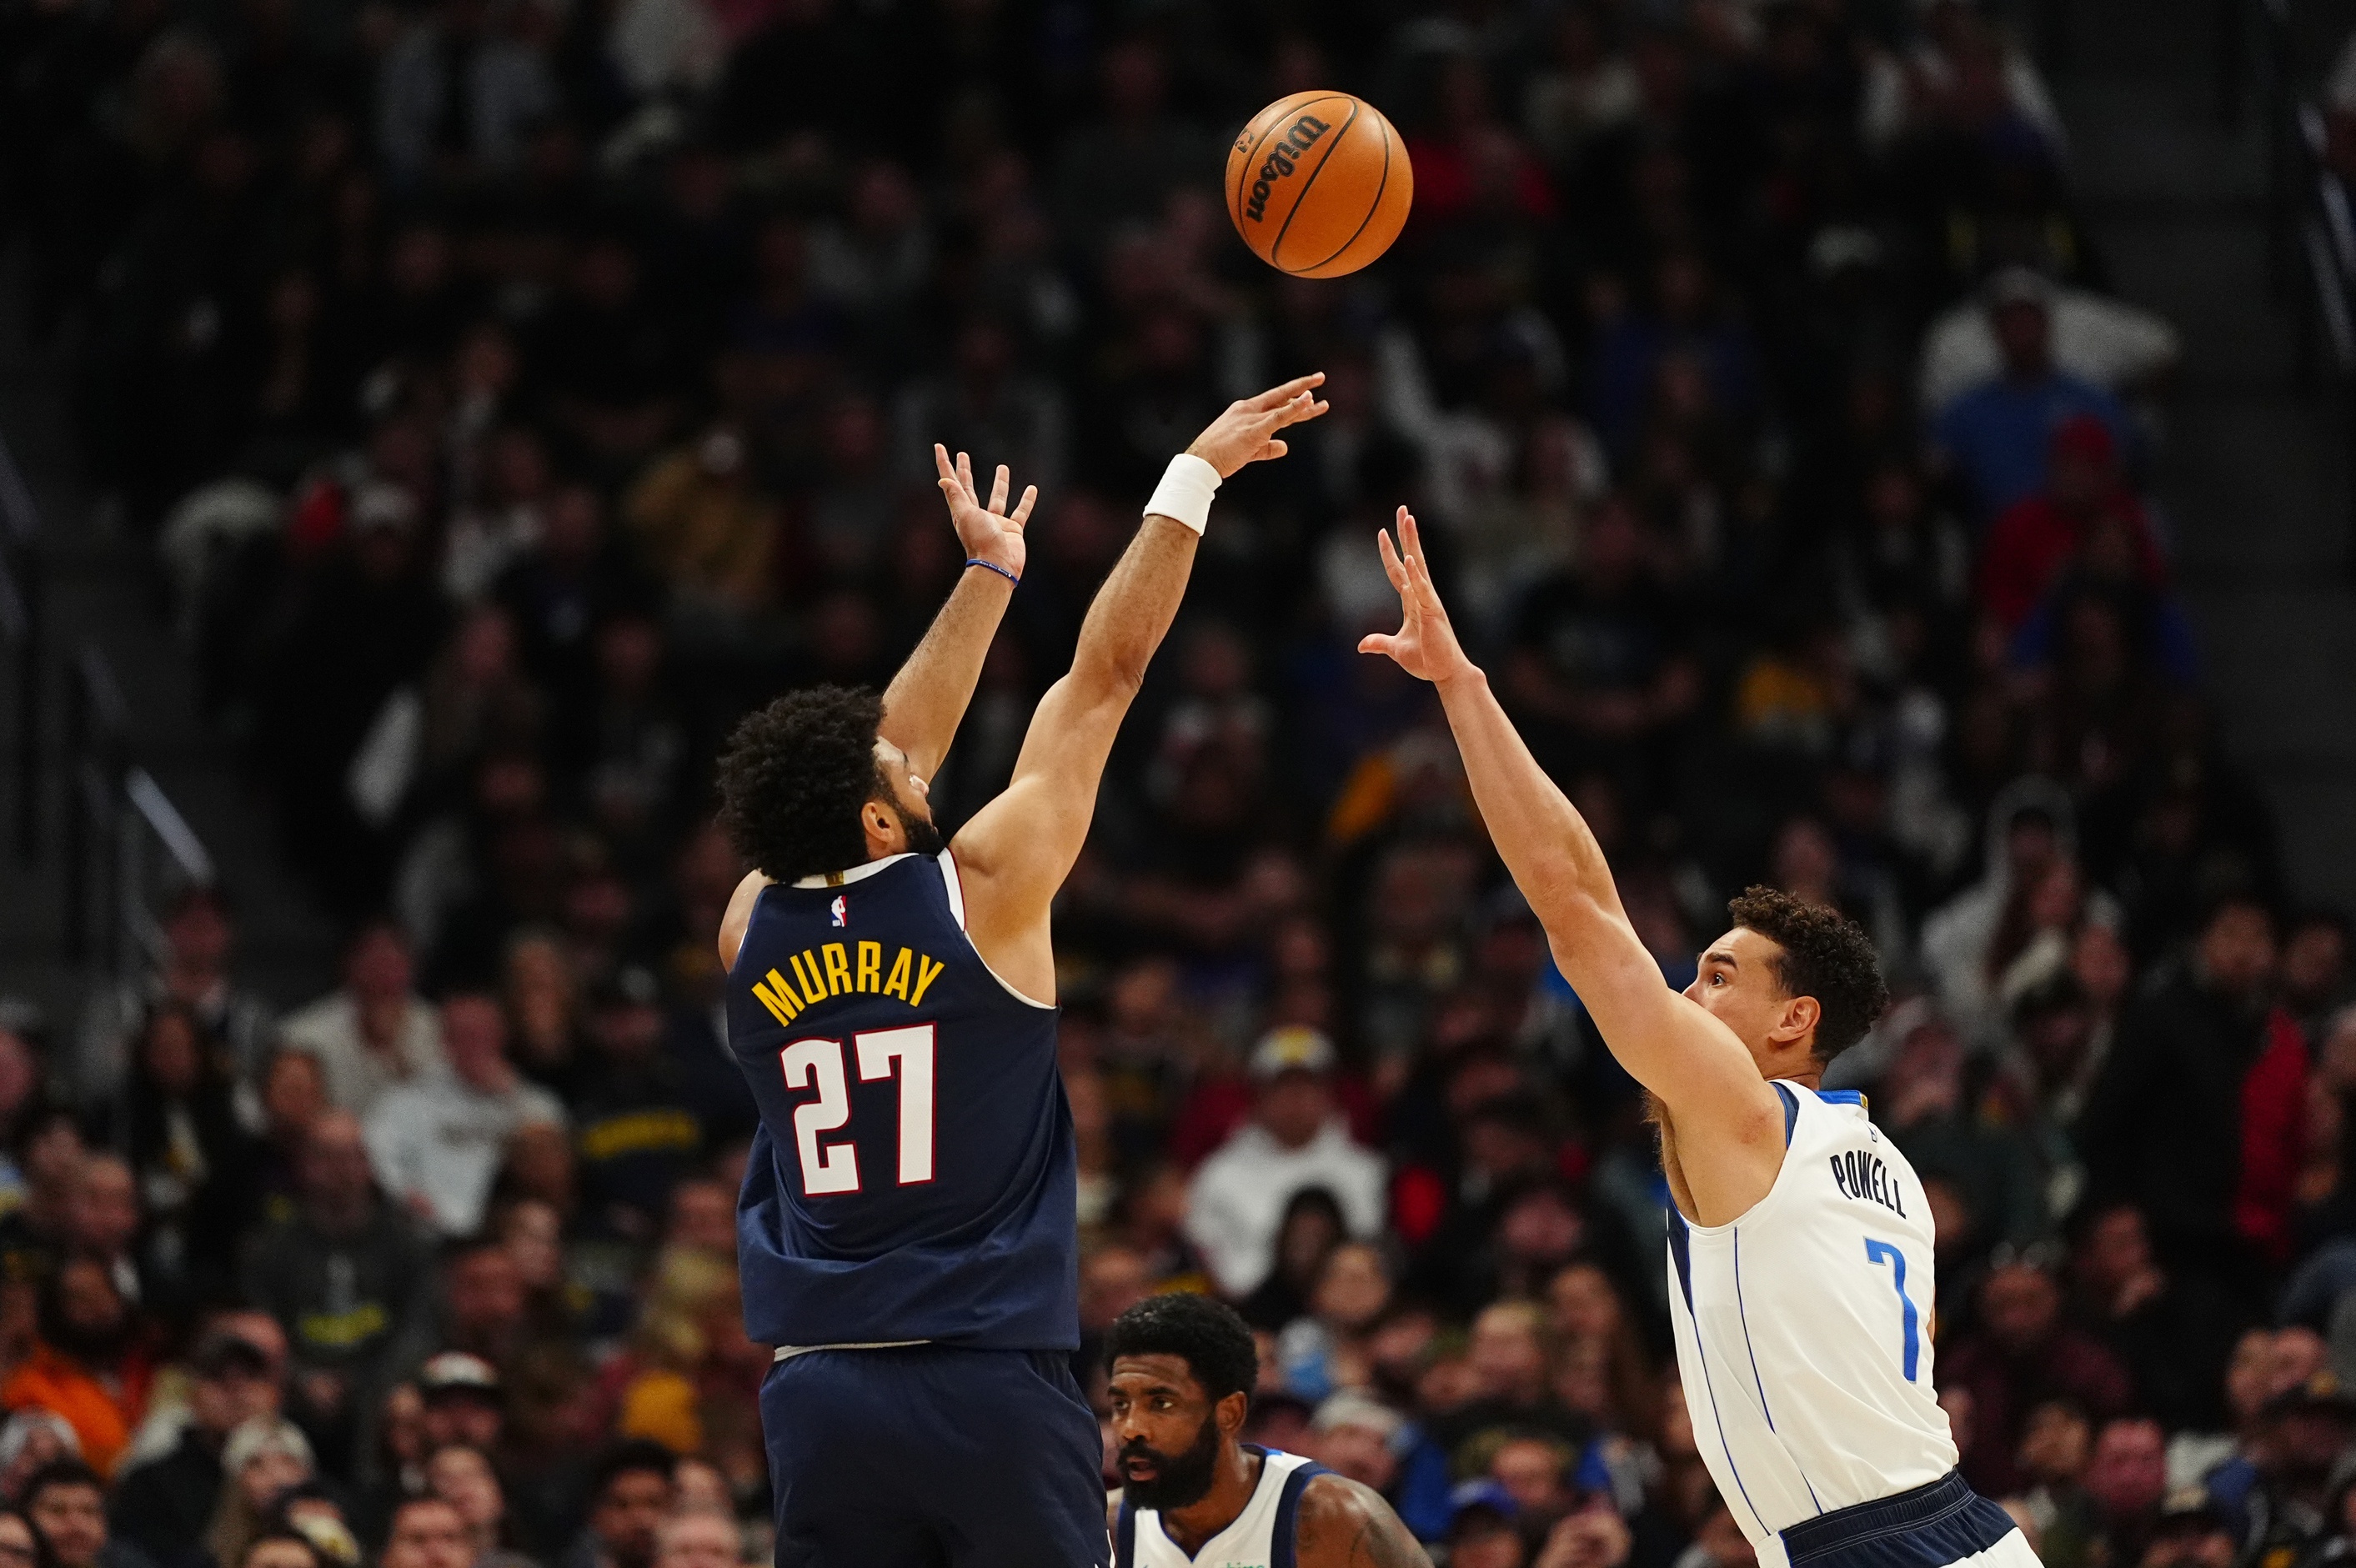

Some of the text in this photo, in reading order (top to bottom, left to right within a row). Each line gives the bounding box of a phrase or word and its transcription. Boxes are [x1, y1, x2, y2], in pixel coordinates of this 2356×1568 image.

[1246, 115, 1331, 223] Wilson
[751, 940, 945, 1027] MURRAY
[779, 1021, 937, 1198] 27
[1829, 1150, 1907, 1220] POWELL
[1862, 1235, 1920, 1385] 7
